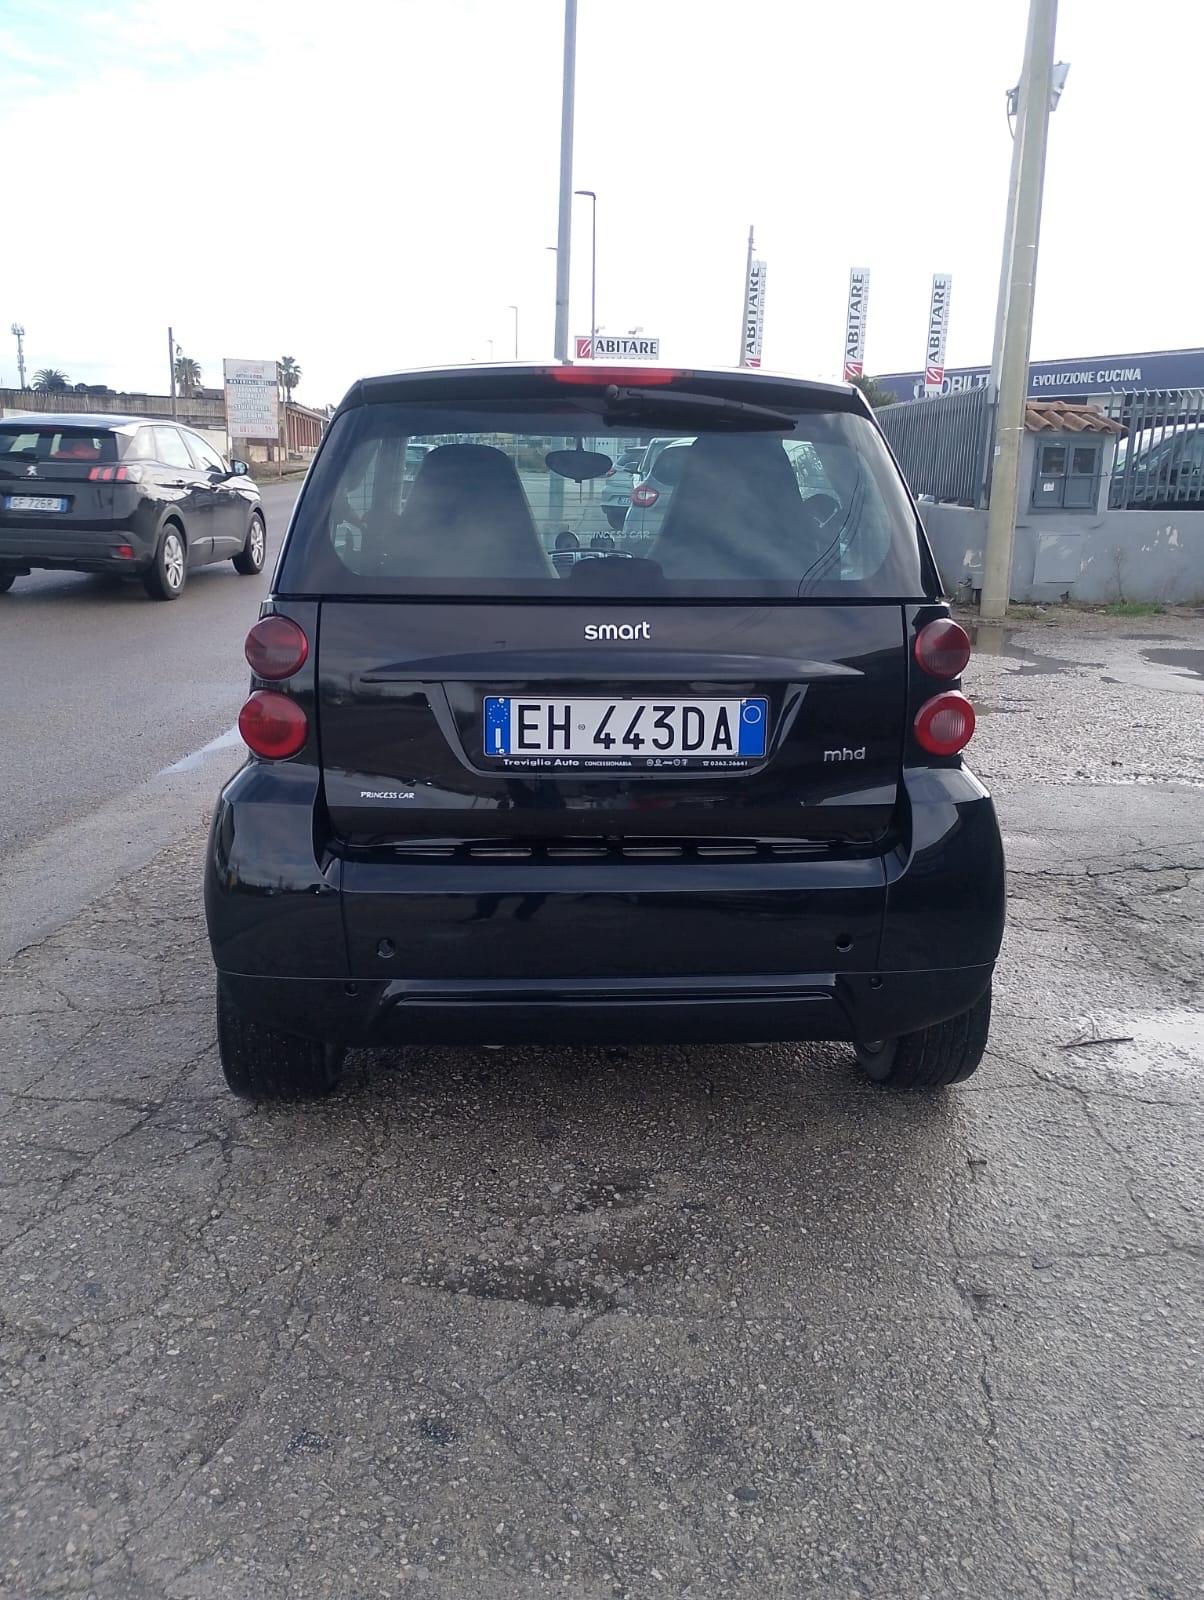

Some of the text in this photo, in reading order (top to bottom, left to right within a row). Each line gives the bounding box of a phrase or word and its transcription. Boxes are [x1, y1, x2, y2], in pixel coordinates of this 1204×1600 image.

[746, 267, 760, 354] ABITARE
[847, 273, 863, 359] ABITARE
[928, 279, 946, 364] ABITARE
[595, 340, 657, 354] ABITARE
[1032, 368, 1142, 387] EVOLUZIONE CUCINA
[584, 621, 651, 640] smart
[517, 704, 571, 750] EH
[592, 705, 734, 751] 443DA
[503, 758, 552, 767] Treviglio
[554, 758, 580, 766] Auto
[823, 746, 866, 762] mhd
[360, 791, 398, 799] PRINCESS
